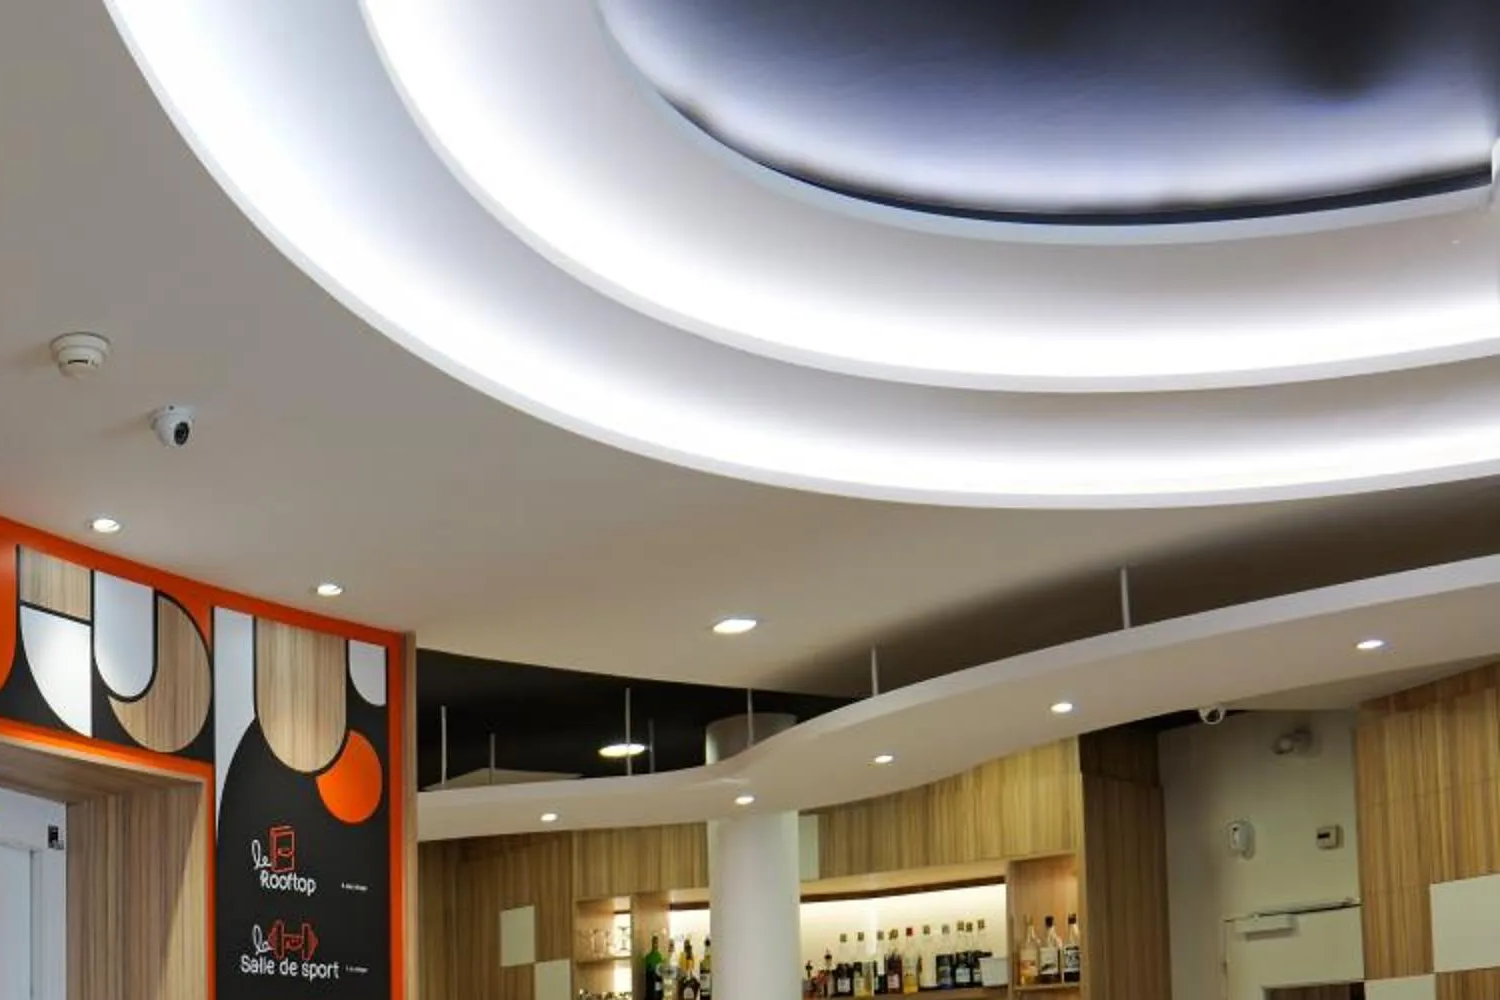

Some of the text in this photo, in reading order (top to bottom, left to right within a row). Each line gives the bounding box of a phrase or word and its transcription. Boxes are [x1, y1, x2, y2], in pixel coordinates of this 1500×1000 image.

[251, 839, 272, 869] le
[260, 869, 317, 896] Rooftop
[240, 954, 275, 975] Salle
[279, 956, 299, 976] de
[301, 961, 340, 981] sport
